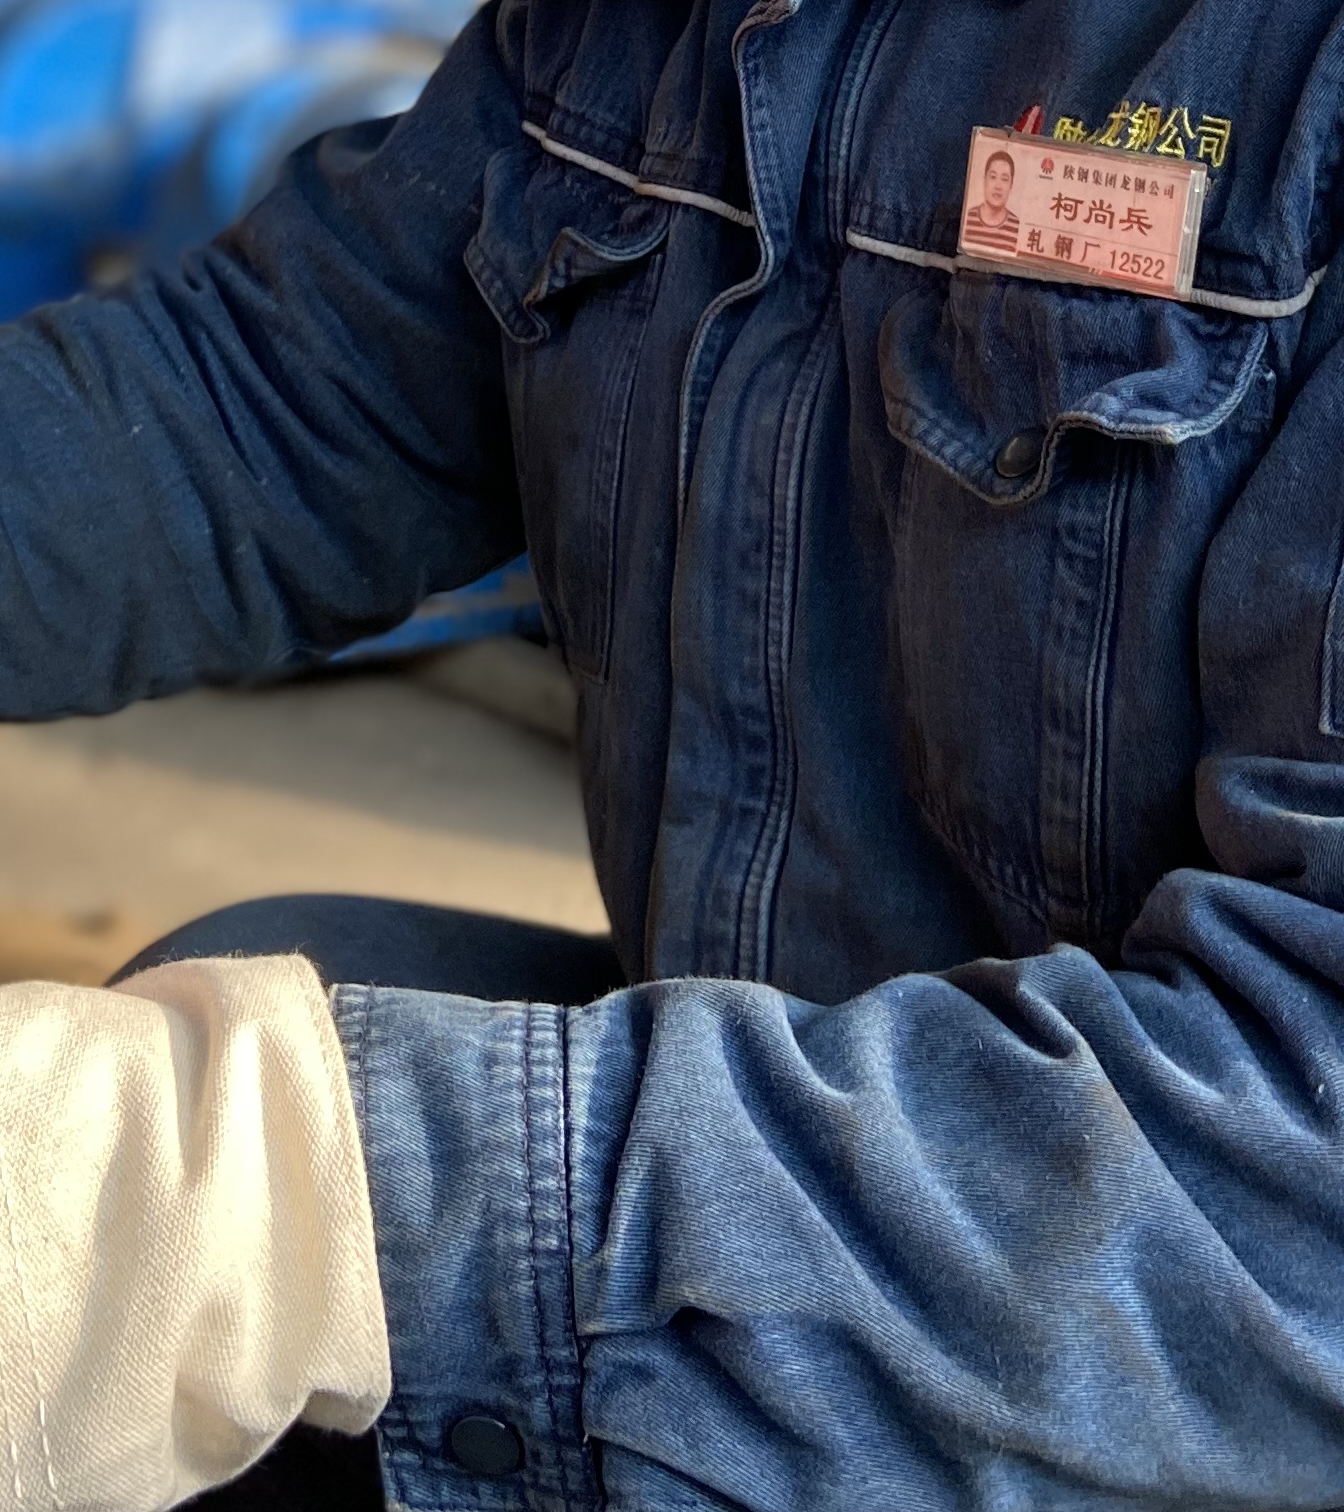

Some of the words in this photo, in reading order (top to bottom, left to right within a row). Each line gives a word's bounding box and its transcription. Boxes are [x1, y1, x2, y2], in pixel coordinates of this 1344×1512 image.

[1062, 164, 1175, 200] 陕钢集团龙钢公司
[1049, 191, 1153, 237] 柯尚兵
[1109, 249, 1166, 281] 12522
